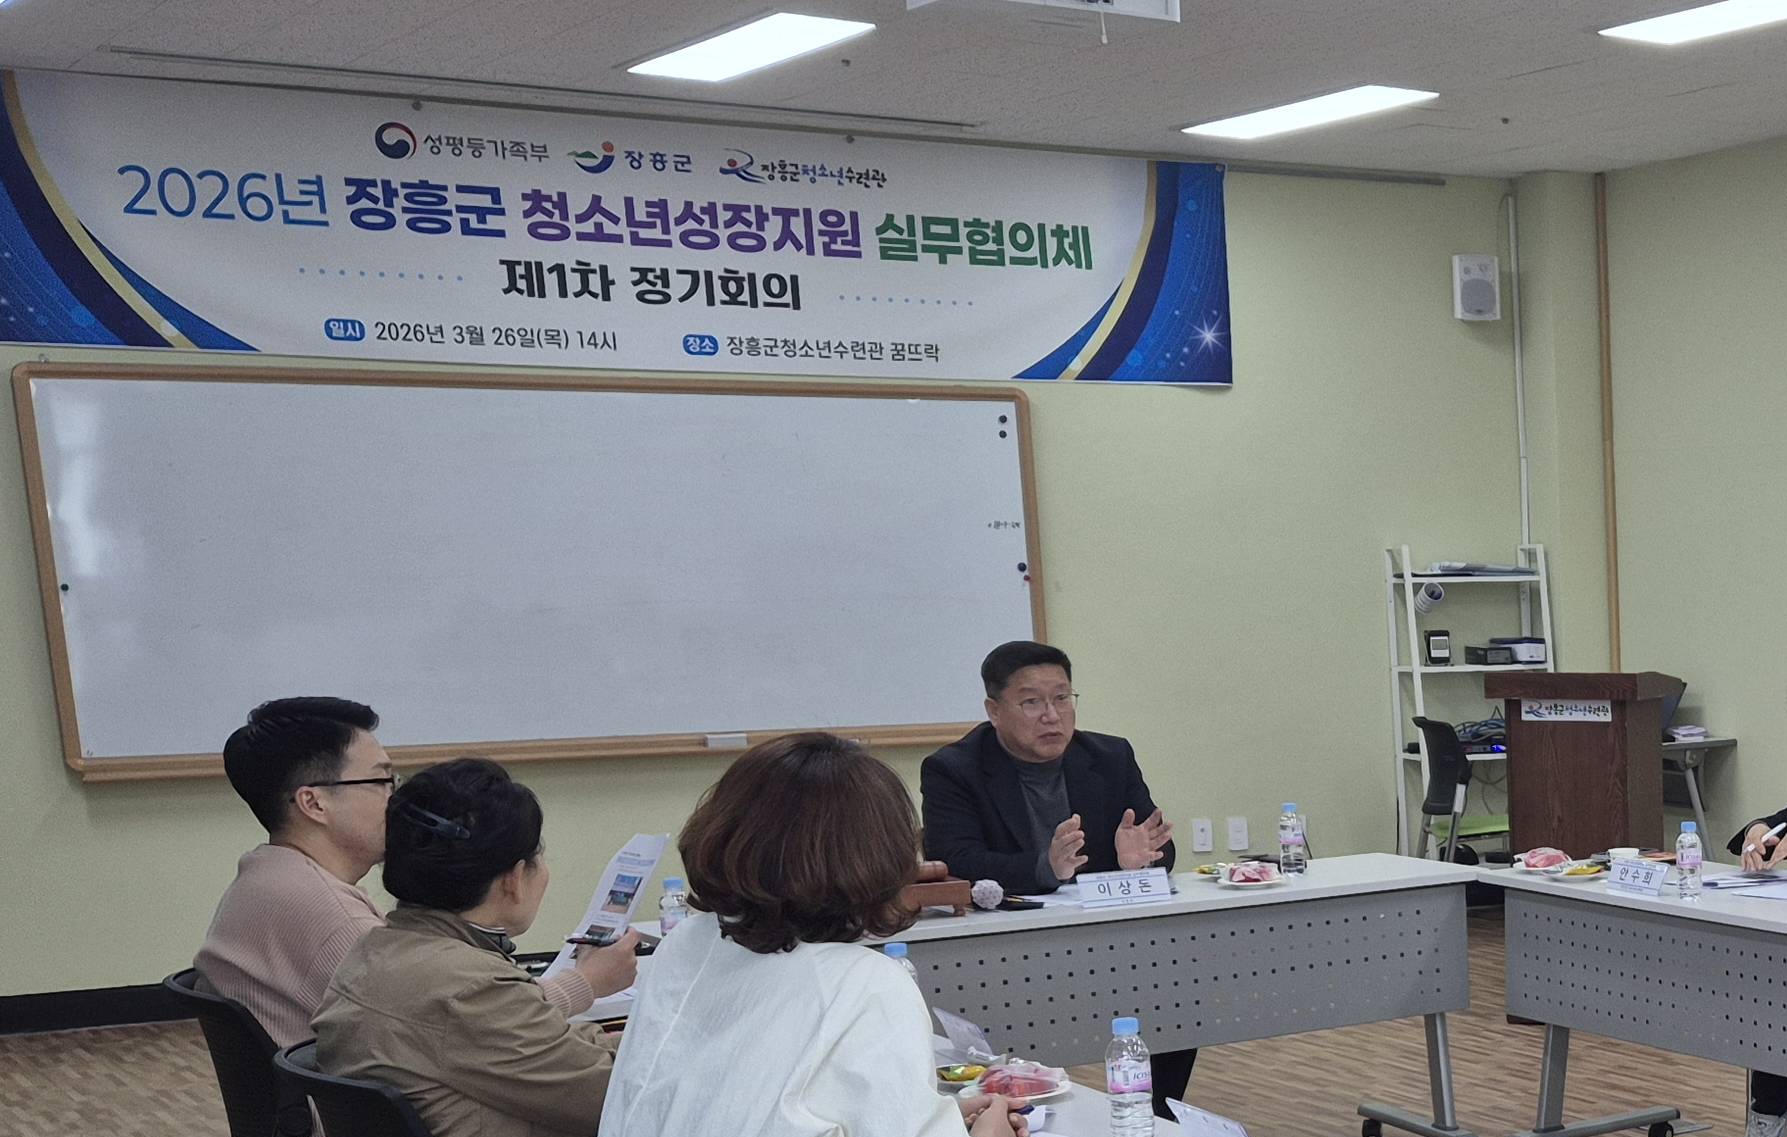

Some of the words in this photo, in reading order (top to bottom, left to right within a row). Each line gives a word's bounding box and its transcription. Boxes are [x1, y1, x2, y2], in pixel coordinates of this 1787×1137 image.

[423, 133, 550, 162] 성평등가족부
[624, 150, 692, 173] 장흥군
[760, 159, 888, 189] 장흥군청소년수련관
[116, 164, 330, 227] 2026년
[343, 176, 507, 239] 장흥군
[520, 188, 863, 259] 청소년성장지원
[875, 212, 1093, 270] 실무협의체
[498, 258, 616, 302] 제1차
[629, 265, 802, 311] 정기회의
[328, 320, 362, 339] 일시
[374, 321, 445, 344] 2026년
[452, 325, 486, 346] 3월
[493, 327, 570, 350] 26일(목)
[576, 330, 618, 351] 14시
[685, 336, 717, 354] 장소
[726, 336, 884, 361] 장흥군청소년수련관
[889, 342, 941, 363] 꿈뜨락
[1097, 878, 1152, 897] 이상돈
